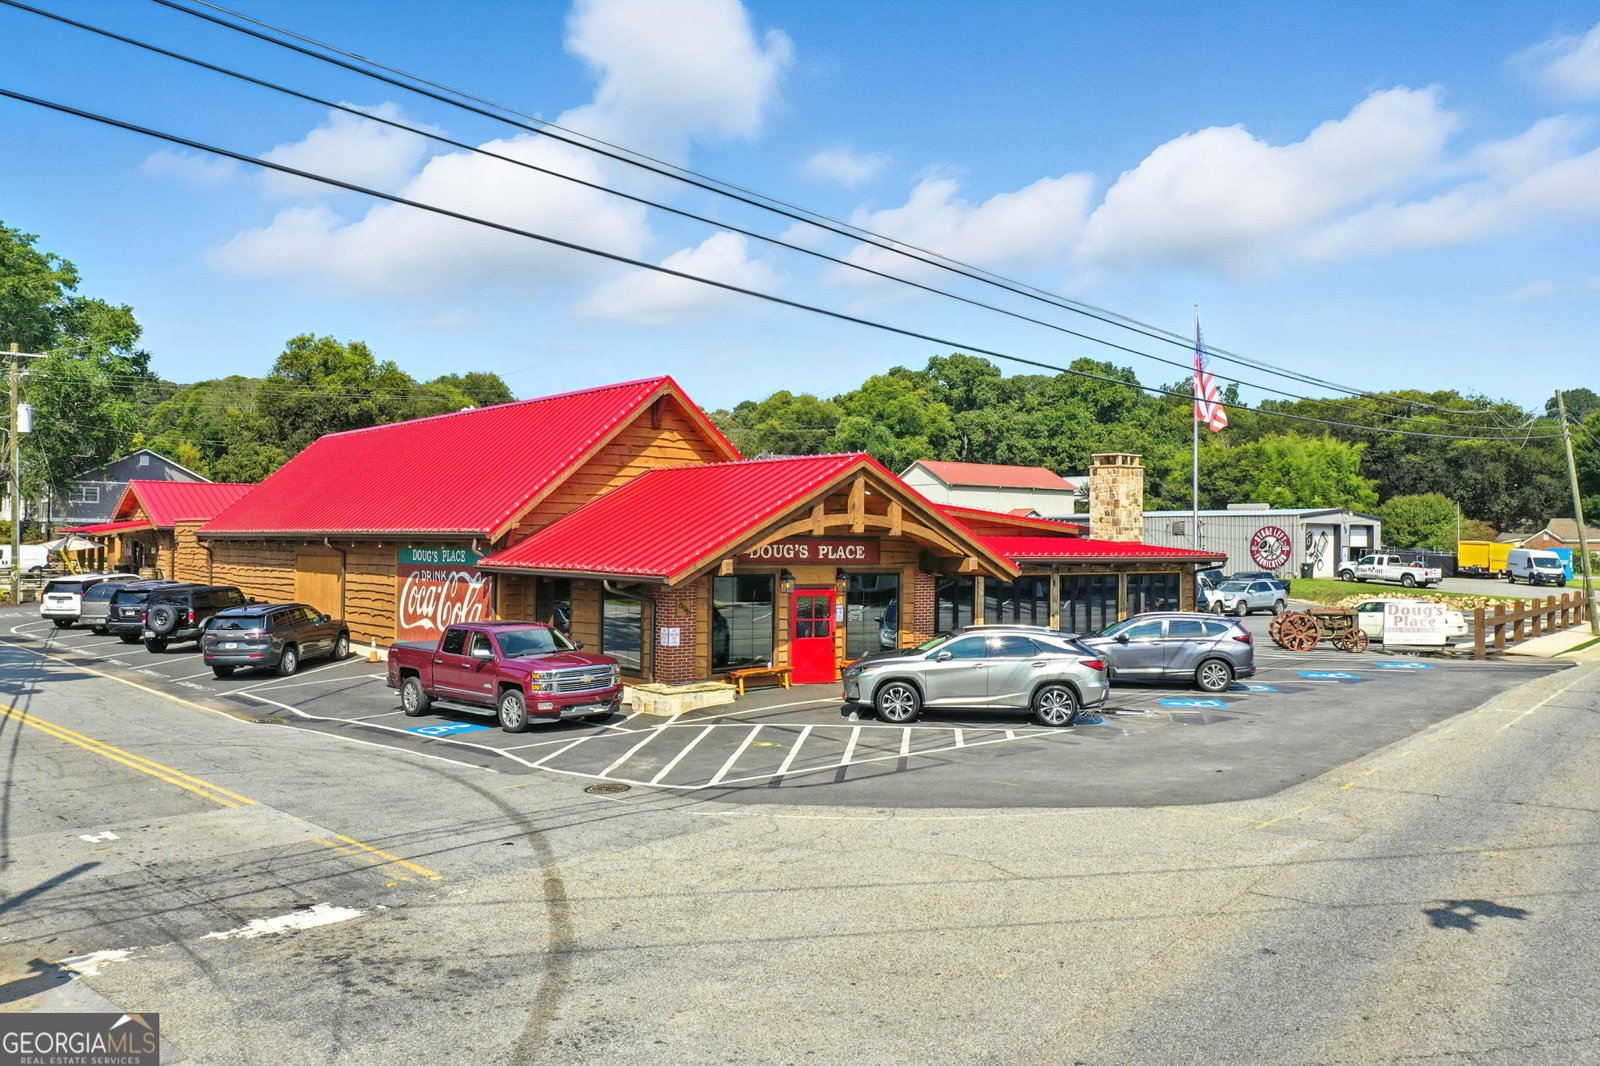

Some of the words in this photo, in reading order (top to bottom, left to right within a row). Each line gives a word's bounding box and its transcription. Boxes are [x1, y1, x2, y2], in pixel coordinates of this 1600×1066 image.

[1254, 528, 1273, 542] STAGE
[1273, 528, 1288, 542] LEFT
[412, 549, 438, 563] DOUG'S
[442, 550, 466, 563] PLACE
[749, 544, 809, 559] DOUG'S
[818, 545, 866, 559] PLACE
[1254, 553, 1288, 568] FABRICATION
[421, 570, 447, 582] DRINK
[400, 570, 488, 632] Coca-Cola
[1388, 604, 1443, 618] Doug's
[1393, 615, 1436, 627] Place
